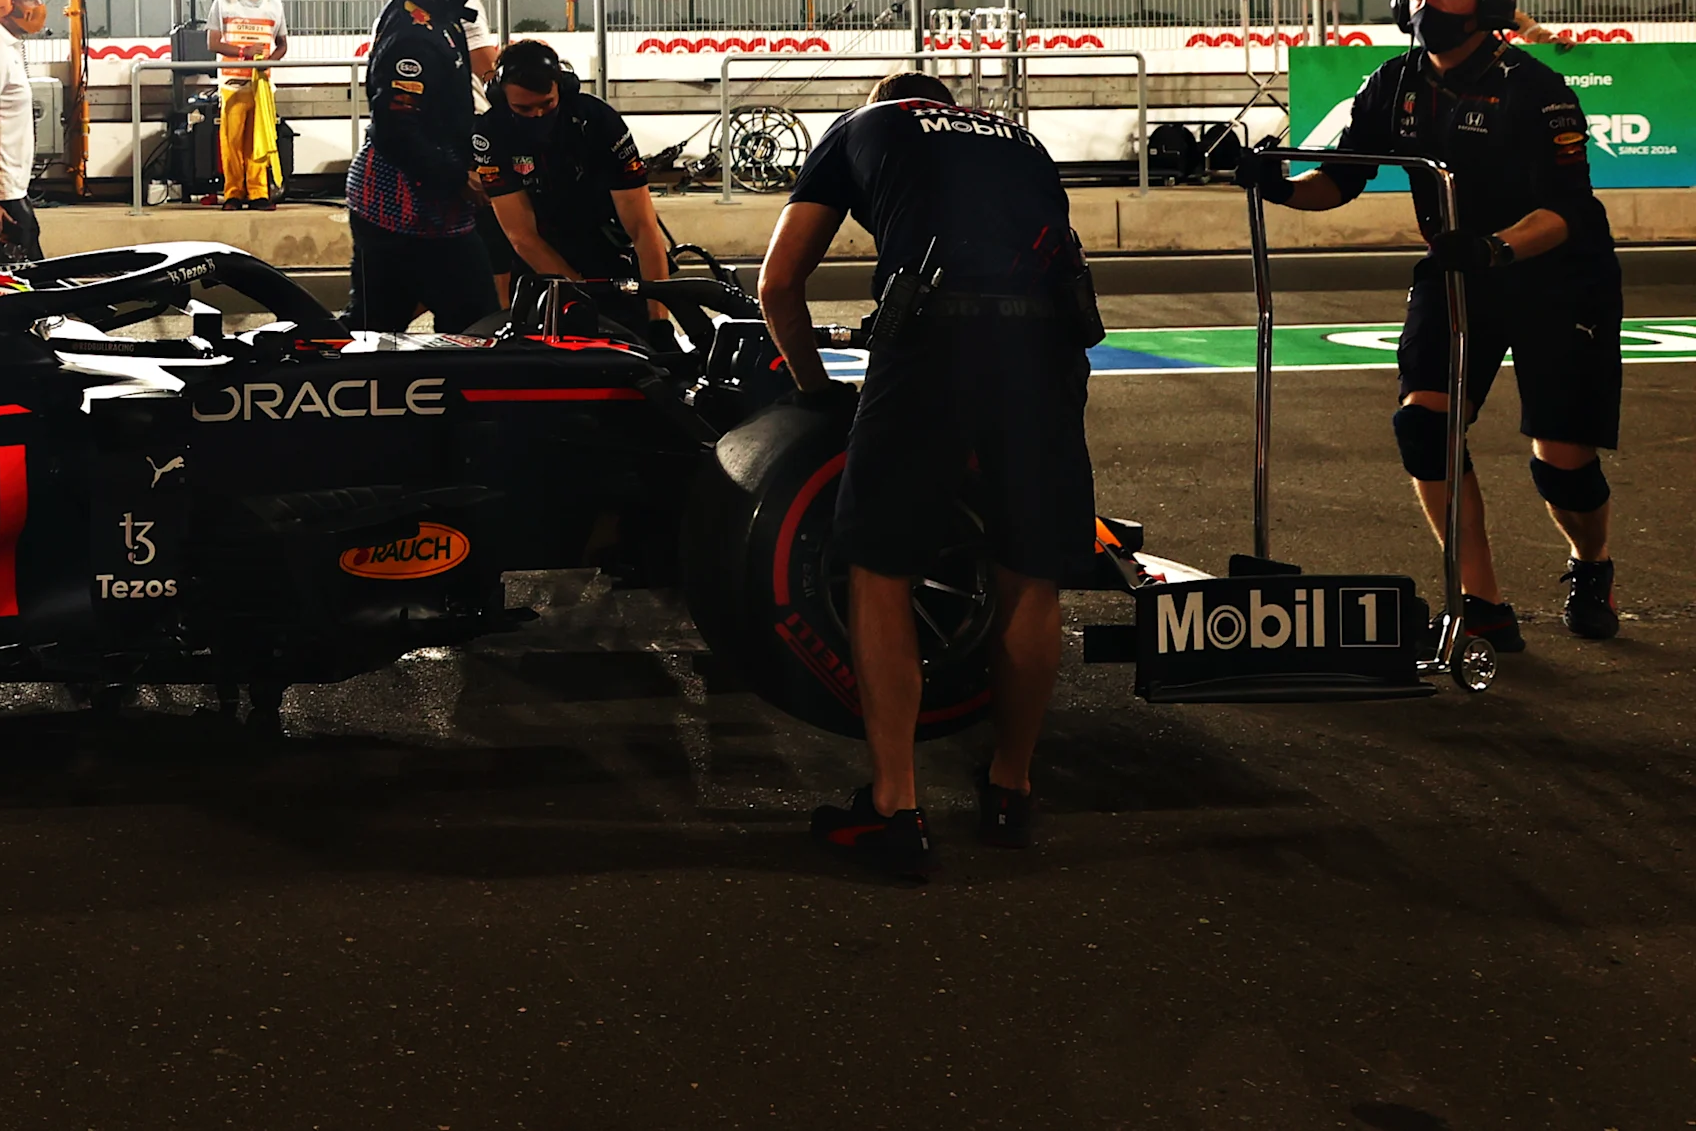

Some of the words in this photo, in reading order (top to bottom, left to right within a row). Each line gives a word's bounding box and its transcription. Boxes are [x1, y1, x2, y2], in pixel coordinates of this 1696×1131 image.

[919, 117, 1013, 139] Mobil
[1587, 114, 1652, 154] RID
[1618, 145, 1649, 156] SINCE
[1650, 145, 1677, 155] 2014
[192, 377, 447, 422] ORACLE
[370, 536, 451, 563] RAUCH
[95, 573, 178, 600] Tezos
[1156, 588, 1326, 653] Mobil
